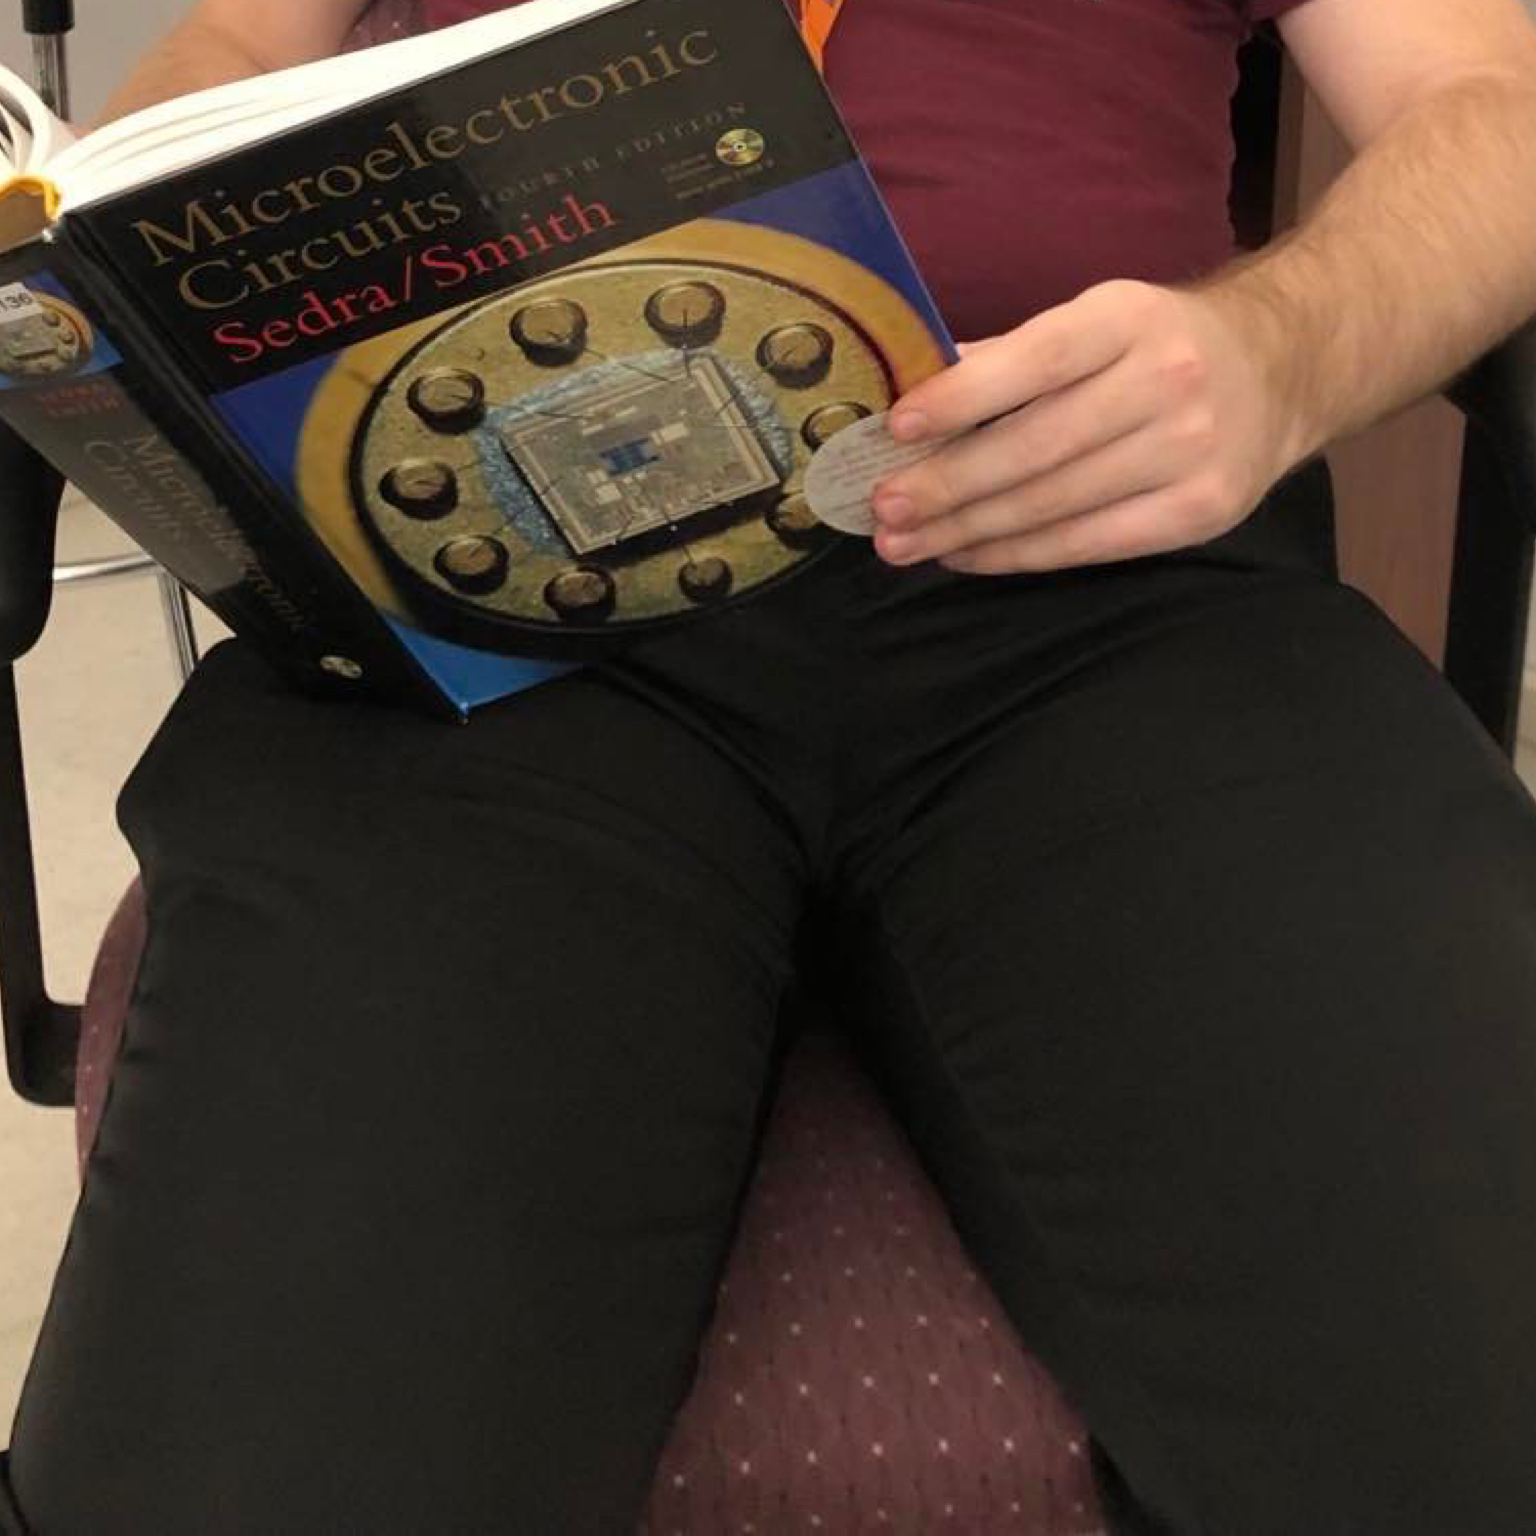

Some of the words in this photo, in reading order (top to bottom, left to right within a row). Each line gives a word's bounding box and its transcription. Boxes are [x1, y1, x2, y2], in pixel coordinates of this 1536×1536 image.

[131, 27, 718, 267] Microelectronic
[176, 189, 462, 311] Circuits
[211, 192, 619, 363] Sedra/Smith
